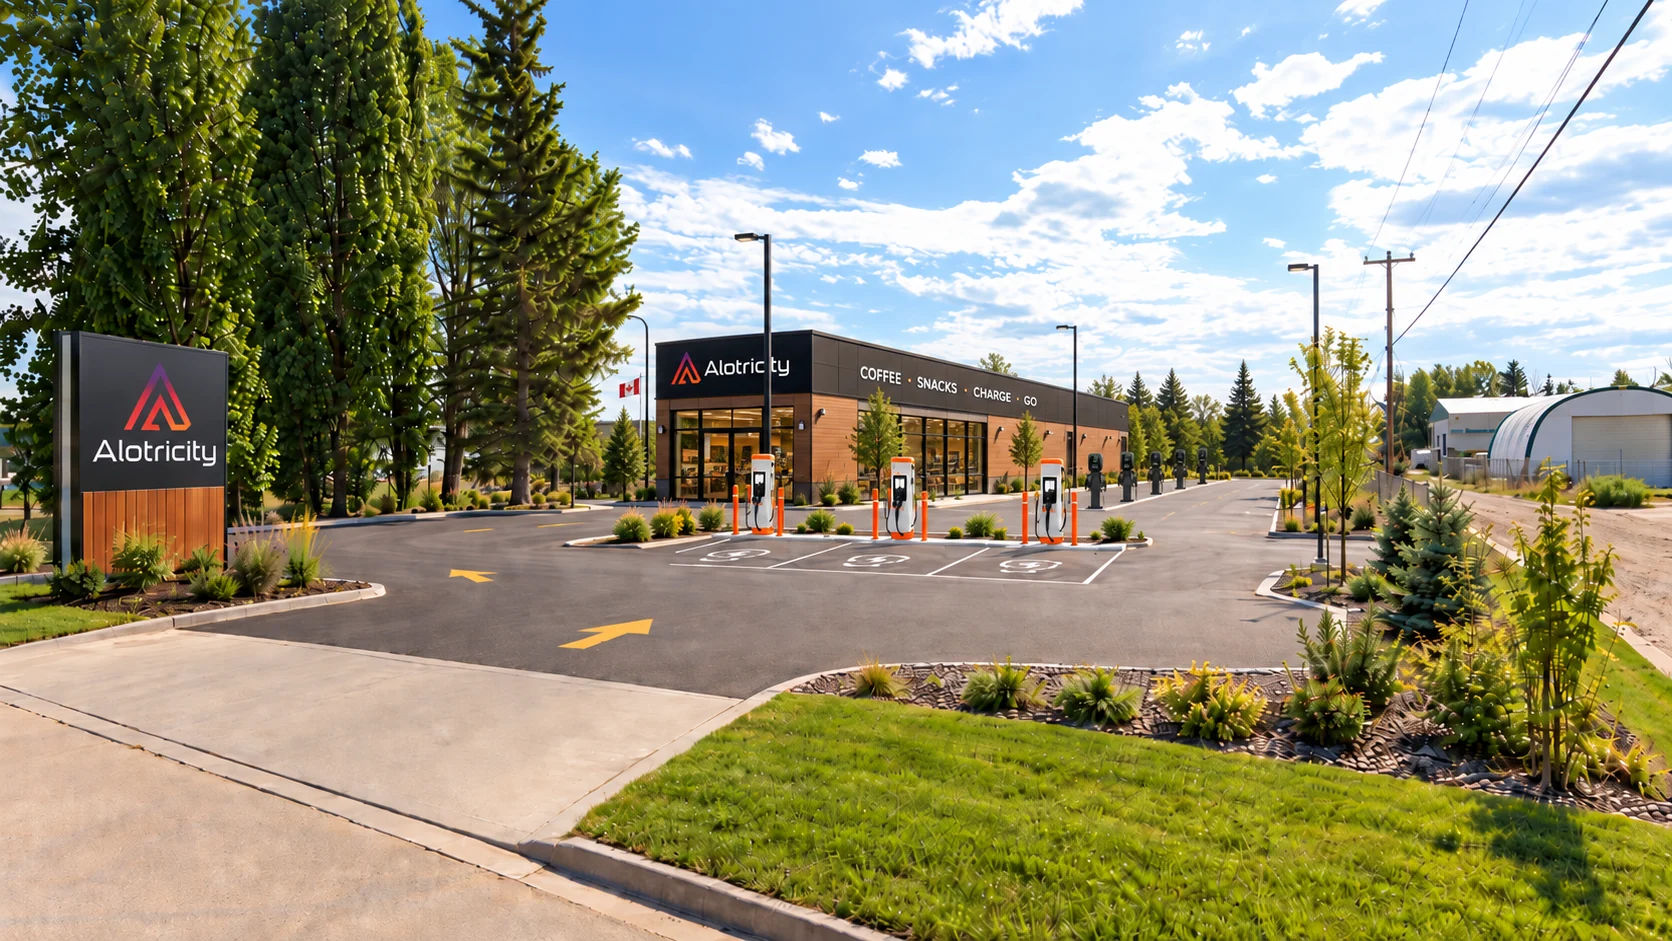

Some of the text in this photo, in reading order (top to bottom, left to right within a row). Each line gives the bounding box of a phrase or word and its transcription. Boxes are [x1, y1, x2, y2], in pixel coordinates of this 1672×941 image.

[704, 356, 790, 377] Alotricty
[860, 366, 1038, 407] COFFEE SNACKS CHARGE GO
[92, 439, 217, 467] Alotricity
